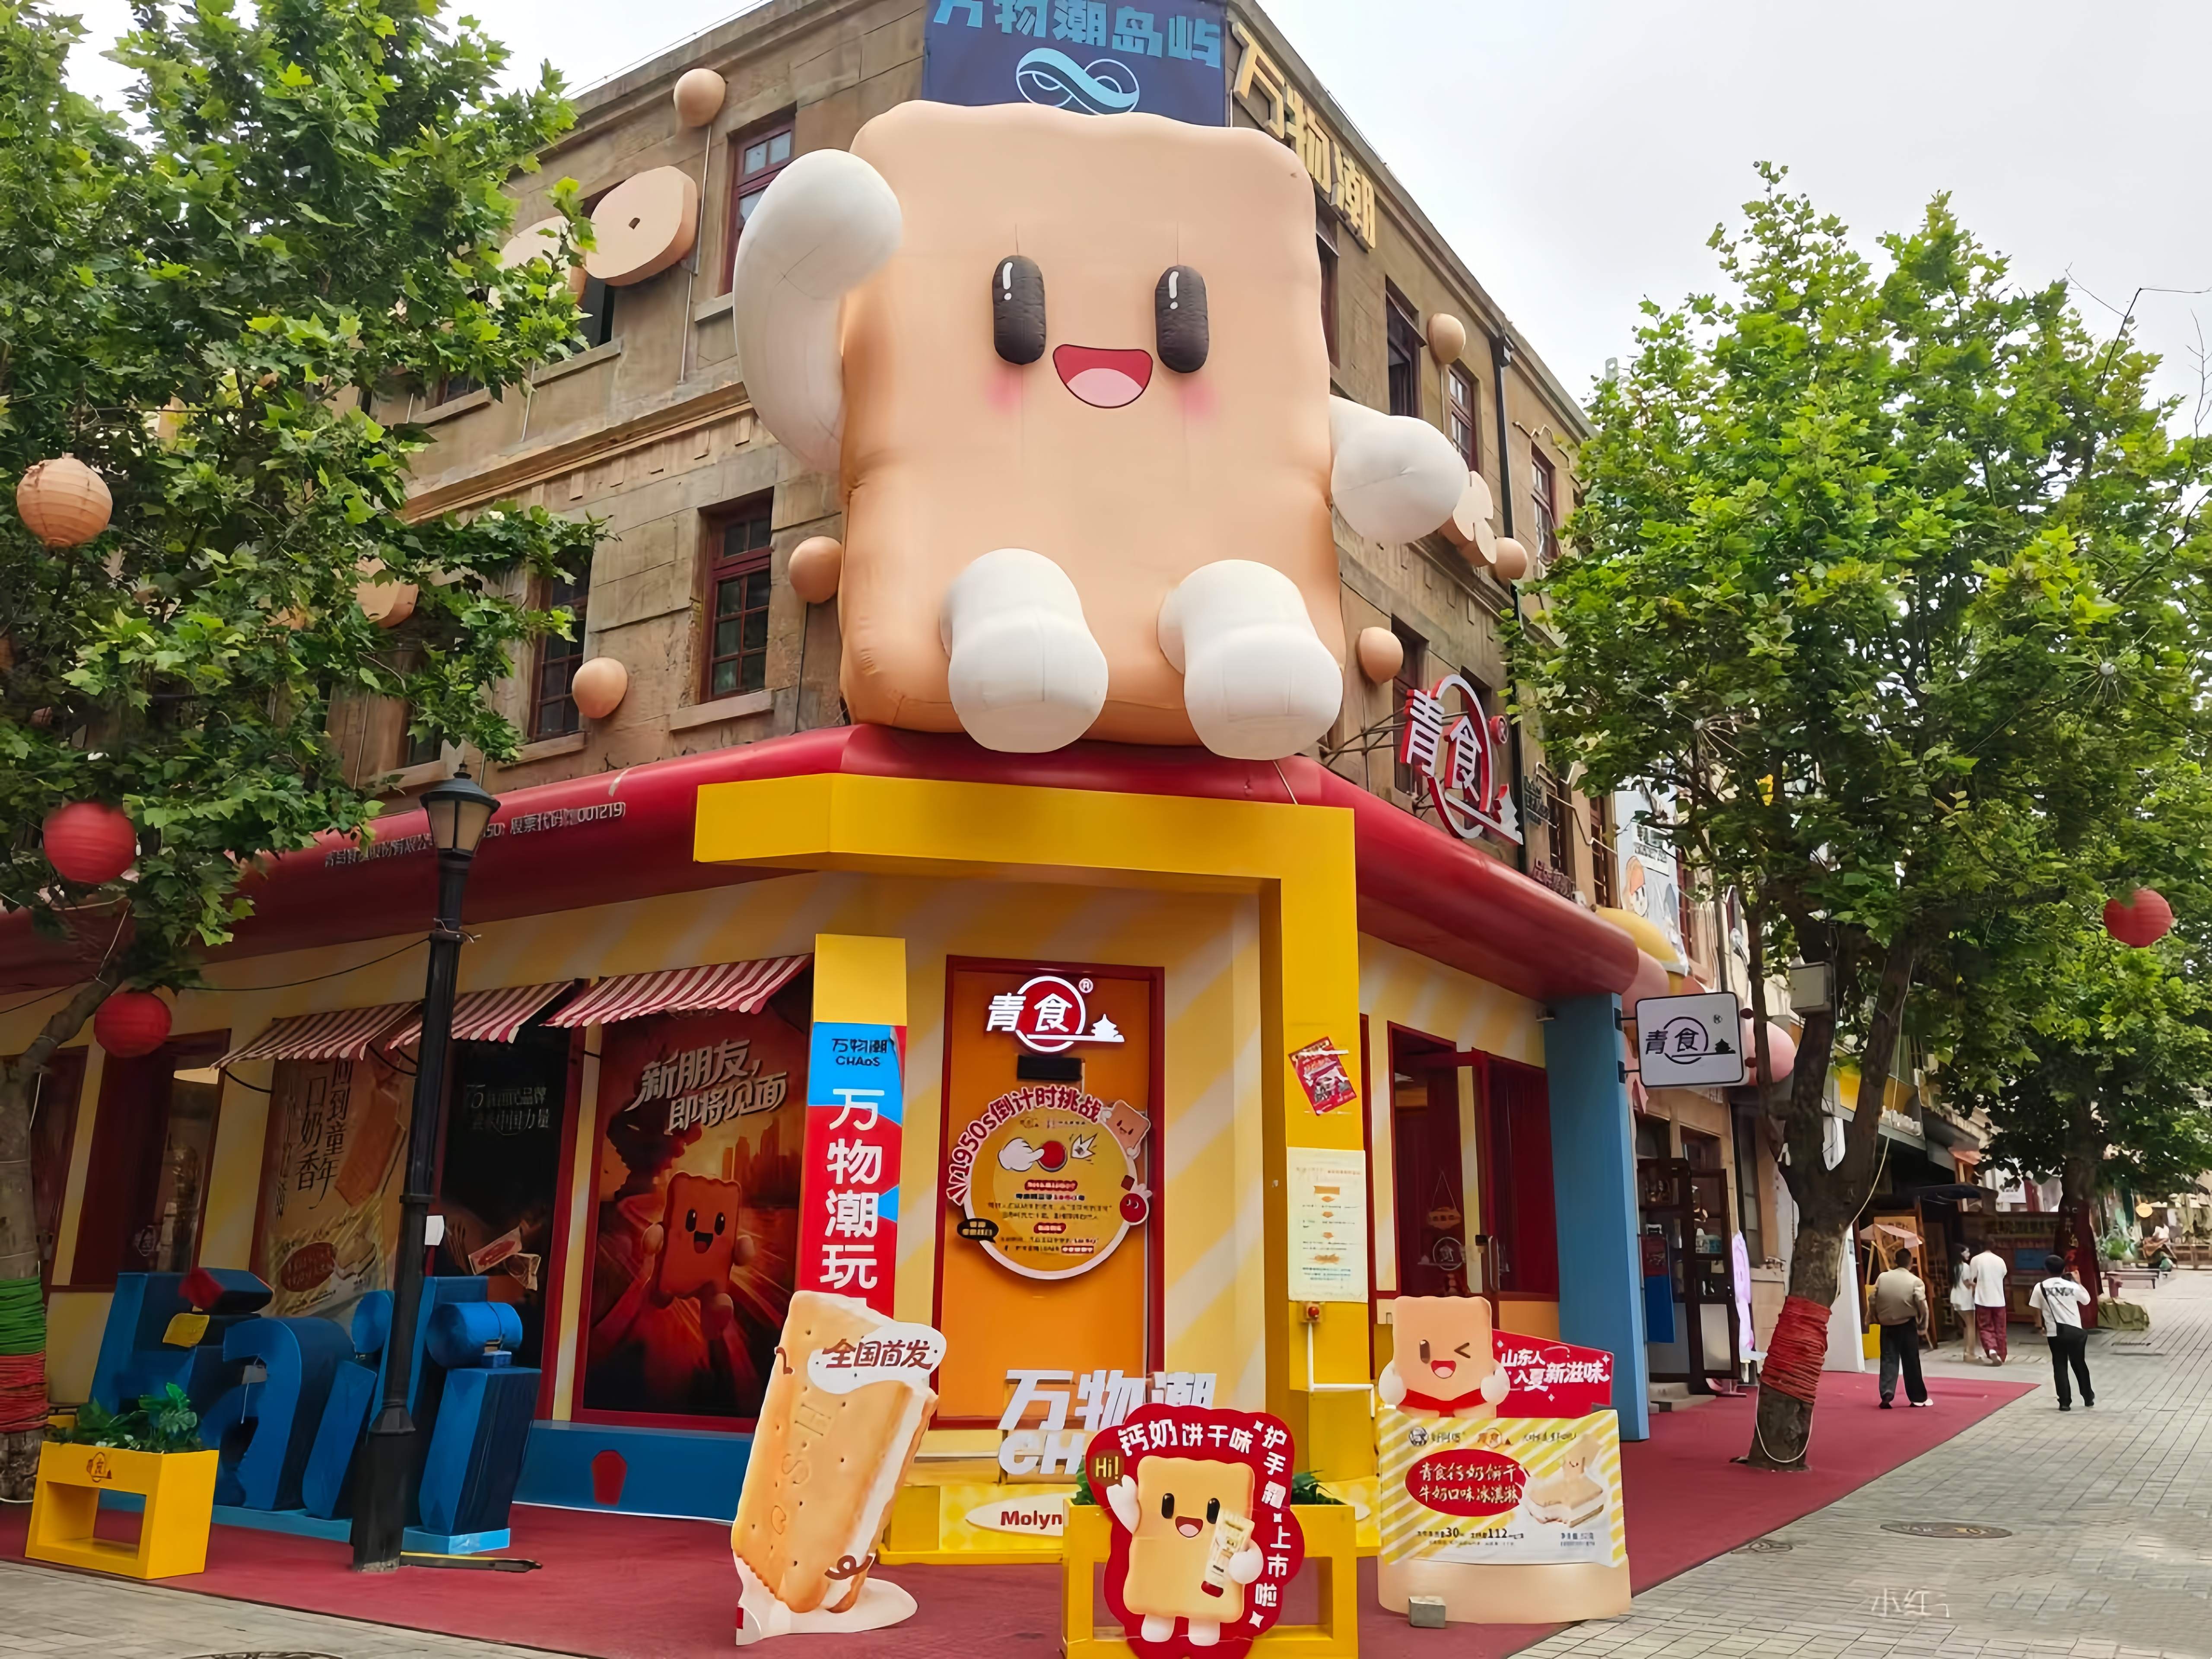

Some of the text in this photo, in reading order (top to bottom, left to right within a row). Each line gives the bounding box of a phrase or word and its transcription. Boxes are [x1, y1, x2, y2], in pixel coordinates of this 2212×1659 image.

[1402, 689, 1483, 801] 青食
[986, 992, 1073, 1032] 青食
[832, 1038, 888, 1054] 万物潮
[1646, 1027, 1699, 1055] 青食
[664, 1071, 787, 1135] 即将见面
[819, 1087, 885, 1290] 万物潮玩
[822, 1338, 934, 1370] 全国首发
[1501, 1348, 1545, 1367] 山东人
[1117, 1418, 1254, 1456] 钙奶饼干味
[1094, 1456, 1119, 1480] Hi!
[1419, 1462, 1516, 1482] 青食钙奶饼干
